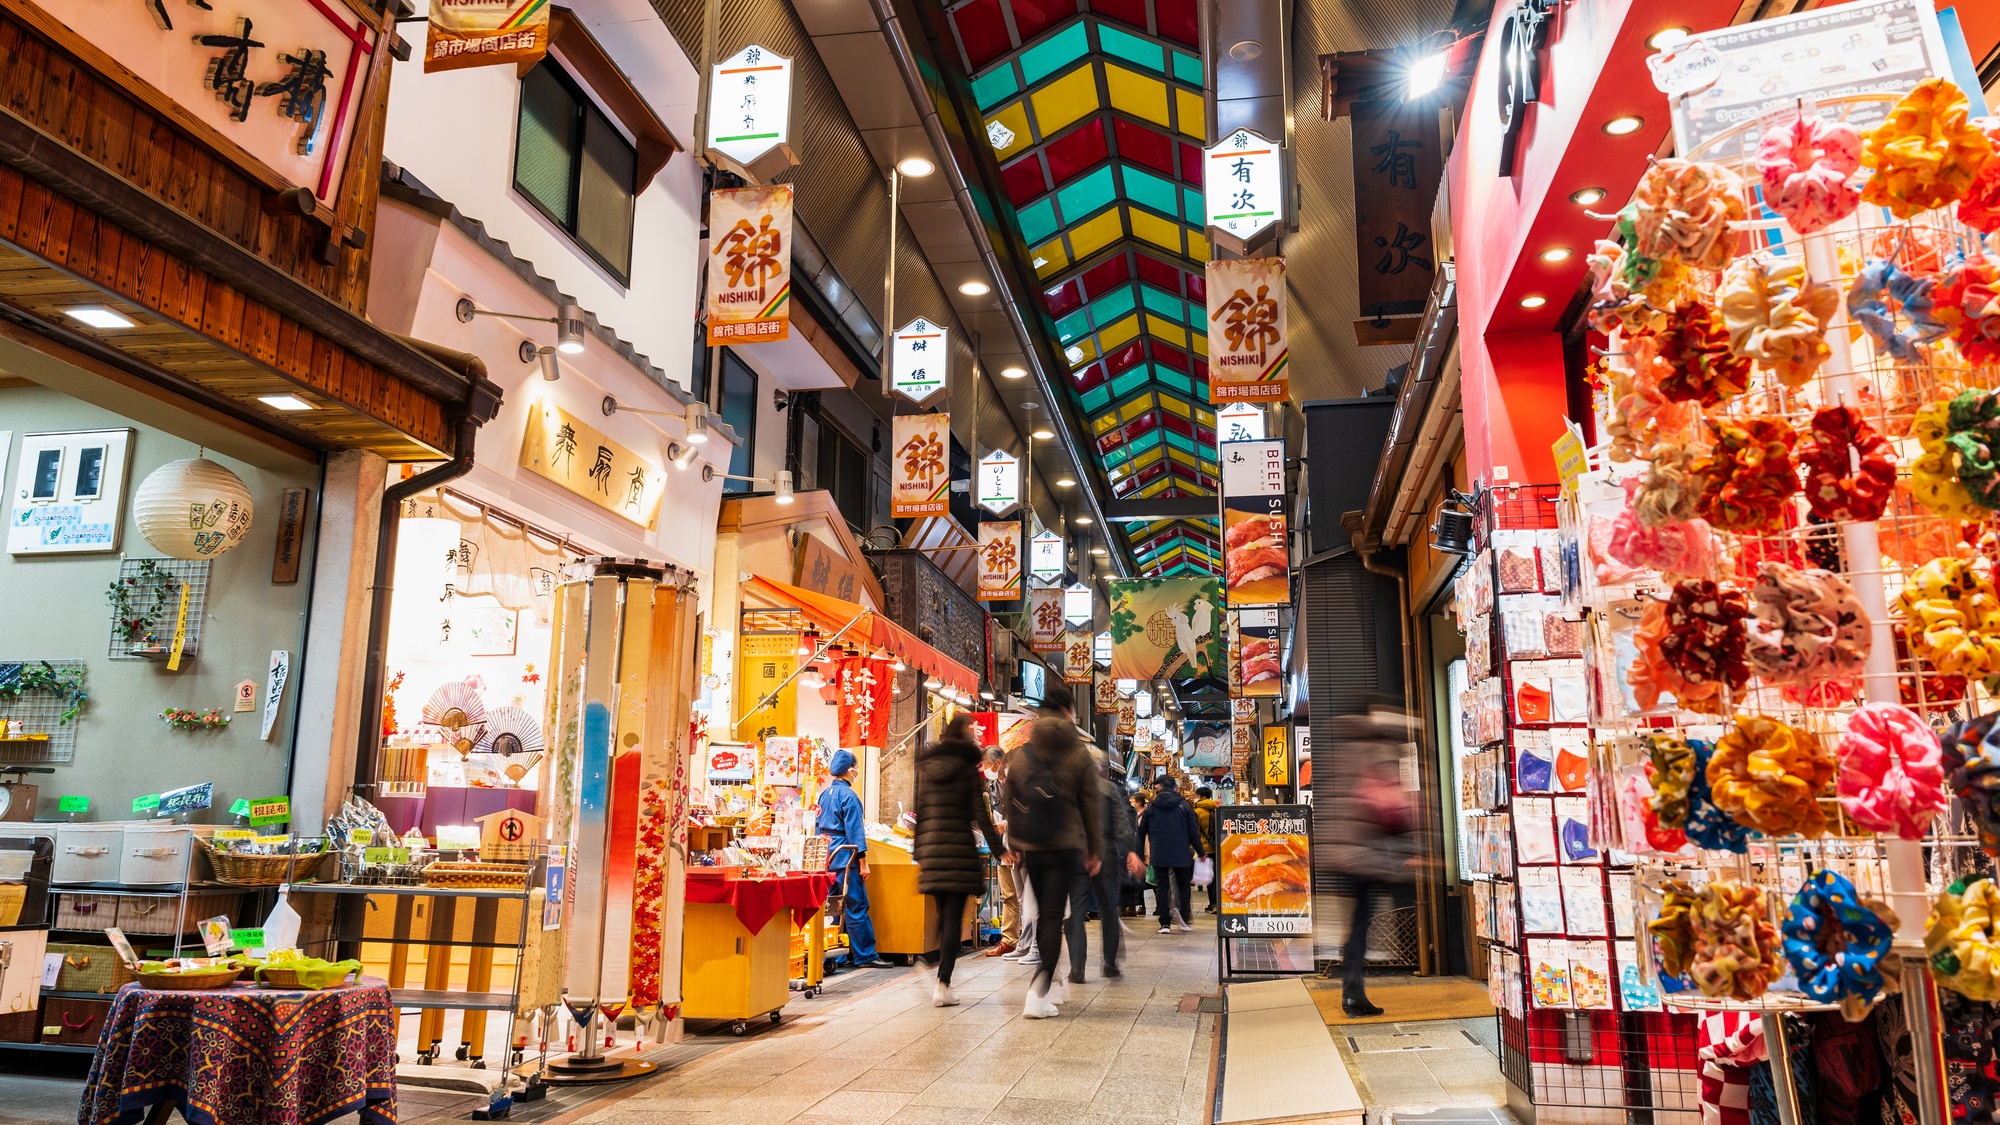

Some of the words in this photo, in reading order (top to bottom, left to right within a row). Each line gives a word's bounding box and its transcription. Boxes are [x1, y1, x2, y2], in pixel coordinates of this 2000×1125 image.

[433, 29, 538, 58] 錦市場商店街
[1231, 158, 1256, 210] 有次
[1371, 130, 1432, 275] 有次
[713, 214, 781, 306] 錦
[719, 289, 759, 304] NISHIKI
[713, 321, 781, 339] 錦市場商店街
[1212, 284, 1281, 367] 錦
[1220, 356, 1260, 366] NISHIKI
[1216, 386, 1282, 398] 錦市場商店街
[895, 431, 945, 491] 錦
[1267, 449, 1281, 491] BEEF
[900, 481, 929, 490] NISHIKI
[896, 502, 944, 513] 錦市場商店街
[1269, 499, 1284, 550] SUSHI
[979, 536, 1017, 581] 錦
[1033, 601, 1064, 637] 錦
[1066, 641, 1092, 672] 錦
[1268, 628, 1278, 661] SUSHI
[1096, 679, 1117, 704] 錦
[253, 803, 288, 818] 根昆布
[1222, 818, 1307, 835] 牛トロ炙り寿司
[374, 852, 402, 862] わかめ
[1267, 920, 1294, 933] 800
